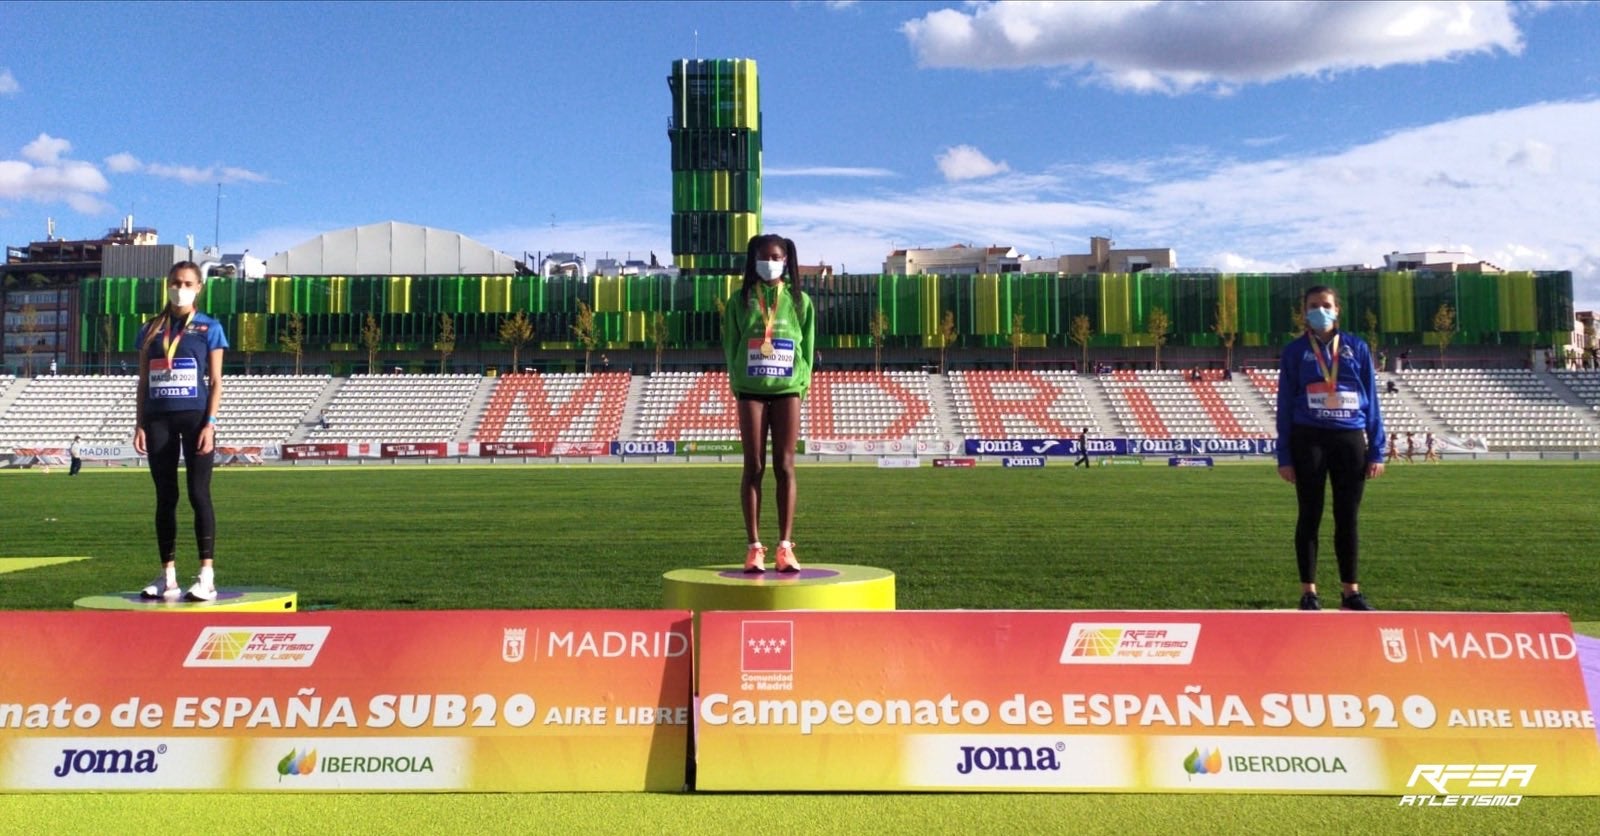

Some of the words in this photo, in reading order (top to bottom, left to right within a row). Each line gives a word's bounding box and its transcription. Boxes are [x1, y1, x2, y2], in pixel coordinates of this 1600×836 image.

[778, 354, 792, 362] 2020
[79, 447, 121, 457] MADRID
[548, 631, 689, 658] MADRID
[1428, 632, 1578, 660] MADRID
[741, 673, 793, 681] Comunidad
[741, 682, 754, 690] de
[757, 682, 793, 690] Madrid
[0, 697, 102, 729] nato
[110, 697, 164, 728] de
[172, 687, 358, 729] ESPAÑA
[366, 693, 537, 728] SUB20
[543, 706, 607, 726] AIRE
[615, 706, 689, 726] LIBRE
[700, 693, 990, 734] Campeonato
[999, 693, 1054, 726] de
[1062, 685, 1255, 728] ESPAÑA
[1262, 693, 1437, 729] SUB20
[1448, 708, 1514, 728] AIRE
[1520, 709, 1596, 729] LIBRE
[321, 756, 434, 773] IBERDROLA
[1228, 755, 1348, 774] IBERDROLA
